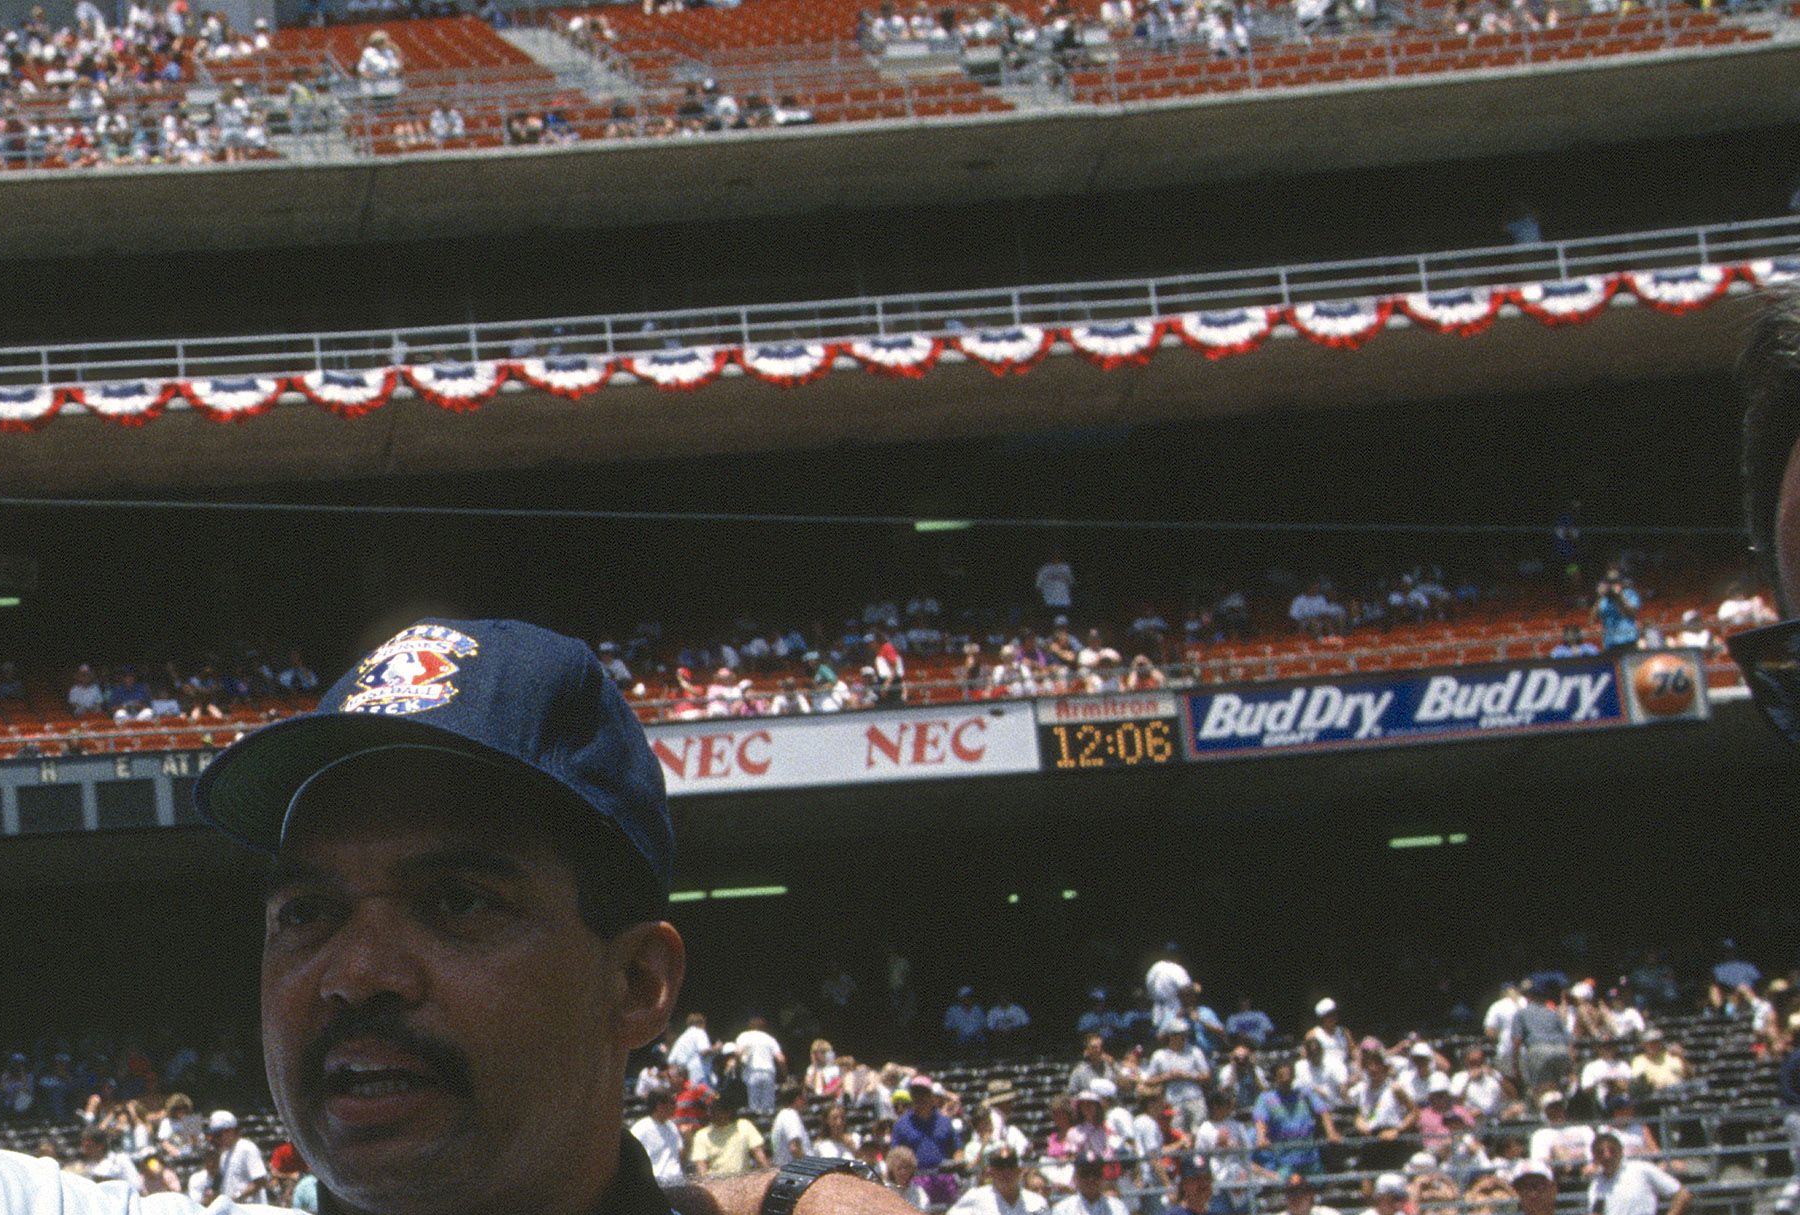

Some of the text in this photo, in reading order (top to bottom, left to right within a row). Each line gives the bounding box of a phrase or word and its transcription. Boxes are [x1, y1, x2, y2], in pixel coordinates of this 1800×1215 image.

[1652, 669, 1691, 696] 76
[653, 730, 772, 780] NEC
[865, 717, 986, 768] NEC
[1053, 720, 1173, 768] 12:06
